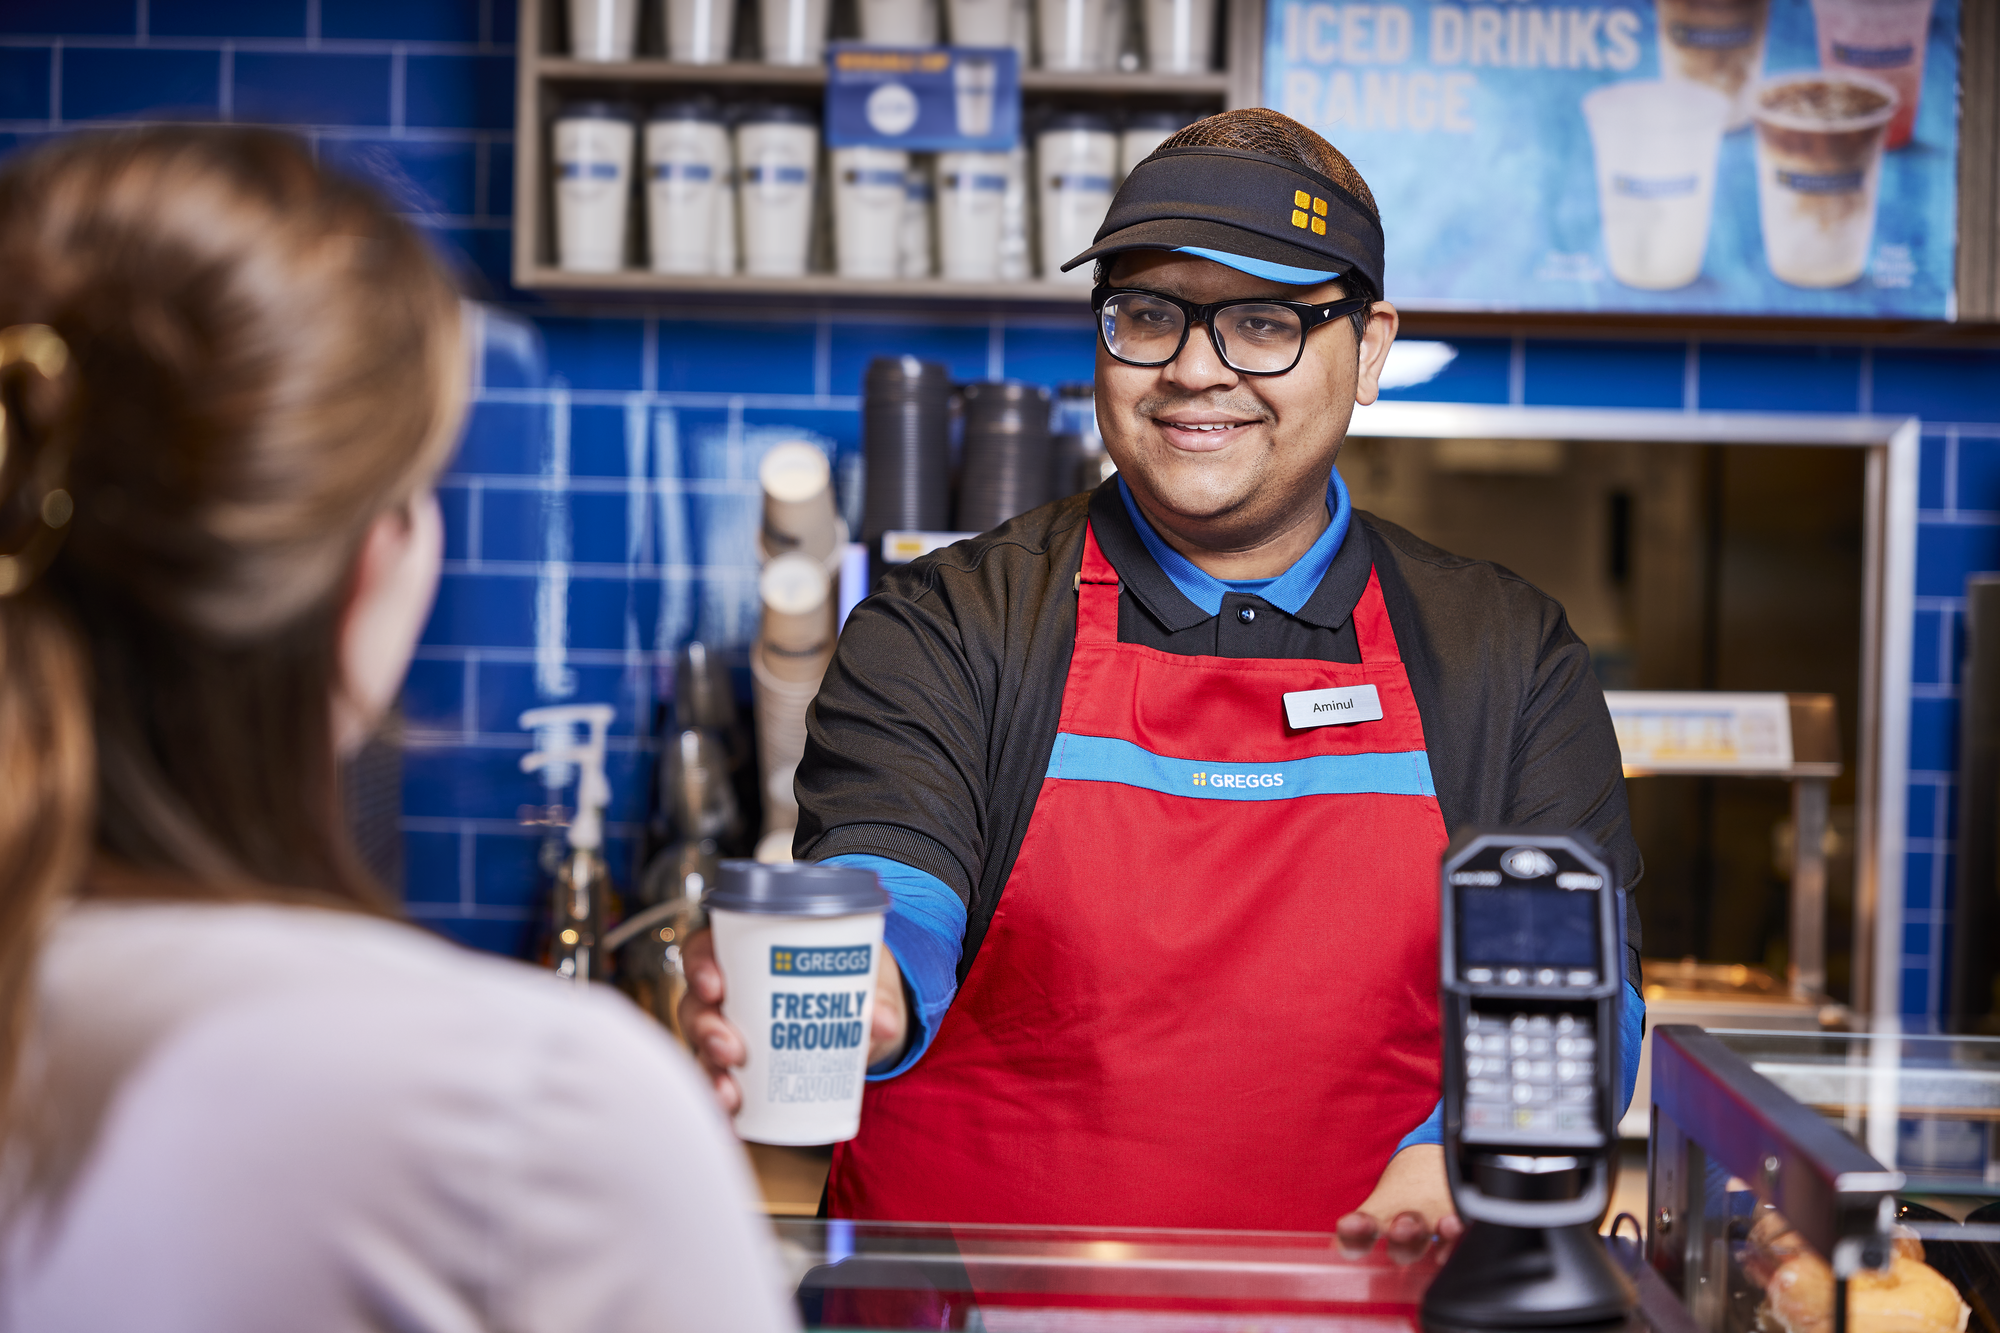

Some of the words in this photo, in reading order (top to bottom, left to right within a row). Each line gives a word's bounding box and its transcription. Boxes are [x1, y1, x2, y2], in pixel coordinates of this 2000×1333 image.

[1284, 2, 1413, 66] ICED
[1430, 9, 1641, 70] DRINKS
[1284, 70, 1476, 132] RANGE
[1313, 698, 1354, 713] Aminul
[1210, 773, 1284, 789] GREGGS
[795, 951, 869, 972] GREGGS
[770, 991, 867, 1020] FRESHLY
[770, 1021, 863, 1051] GROUND
[767, 1074, 856, 1103] FLAVOUR
